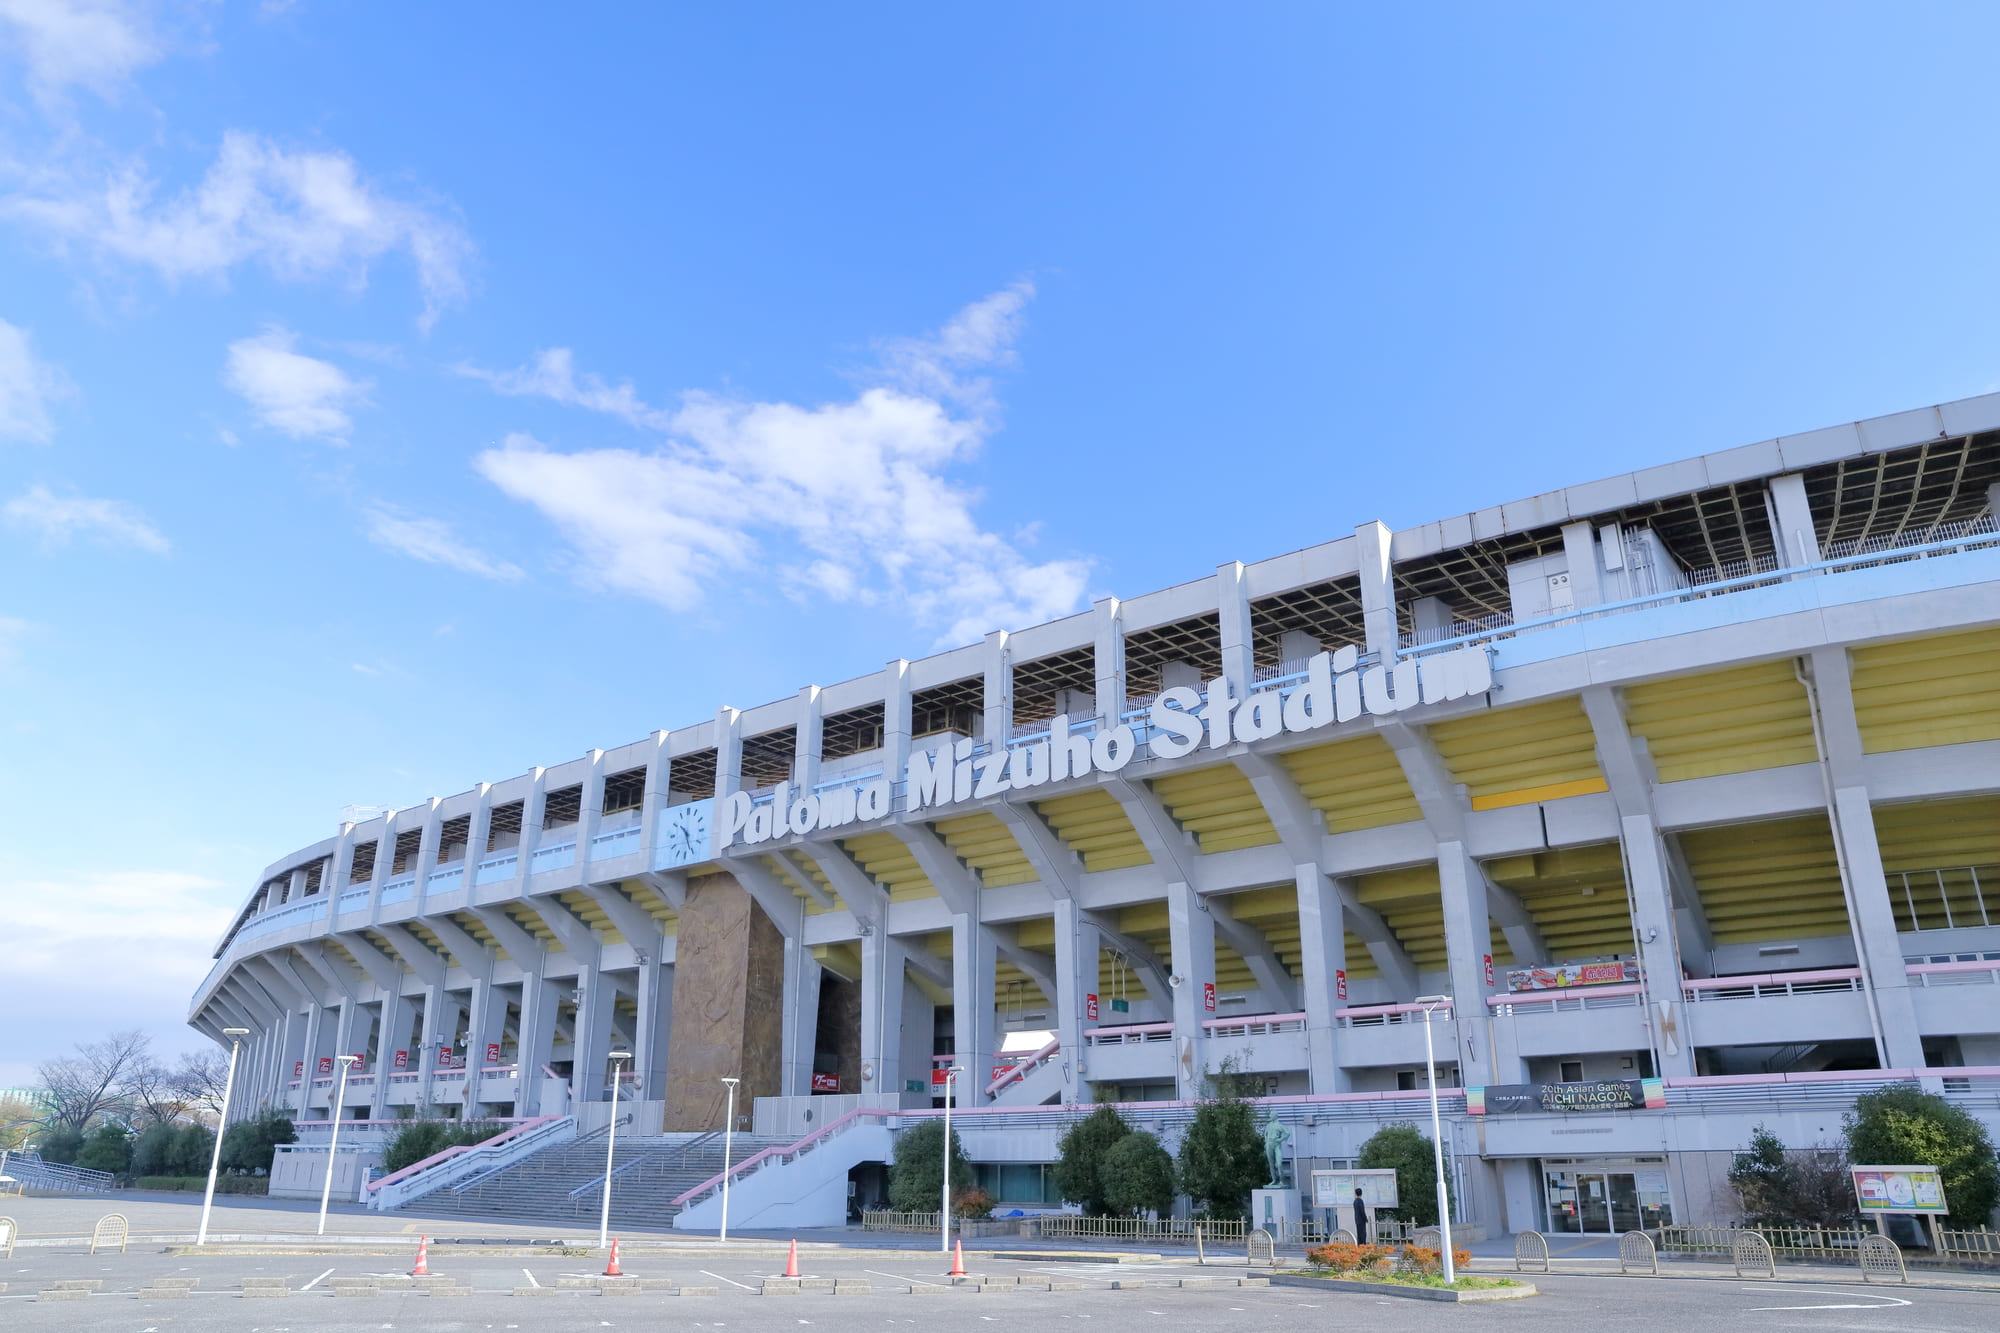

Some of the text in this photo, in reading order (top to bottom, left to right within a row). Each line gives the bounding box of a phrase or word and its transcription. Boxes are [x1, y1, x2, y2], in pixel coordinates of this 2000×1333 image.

[720, 644, 1492, 850] Paloma Mizuho Stadium
[1541, 1083, 1631, 1094] 20th Asian Games
[1542, 1094, 1575, 1104] AICHI
[1578, 1091, 1633, 1103] NAGOYA
